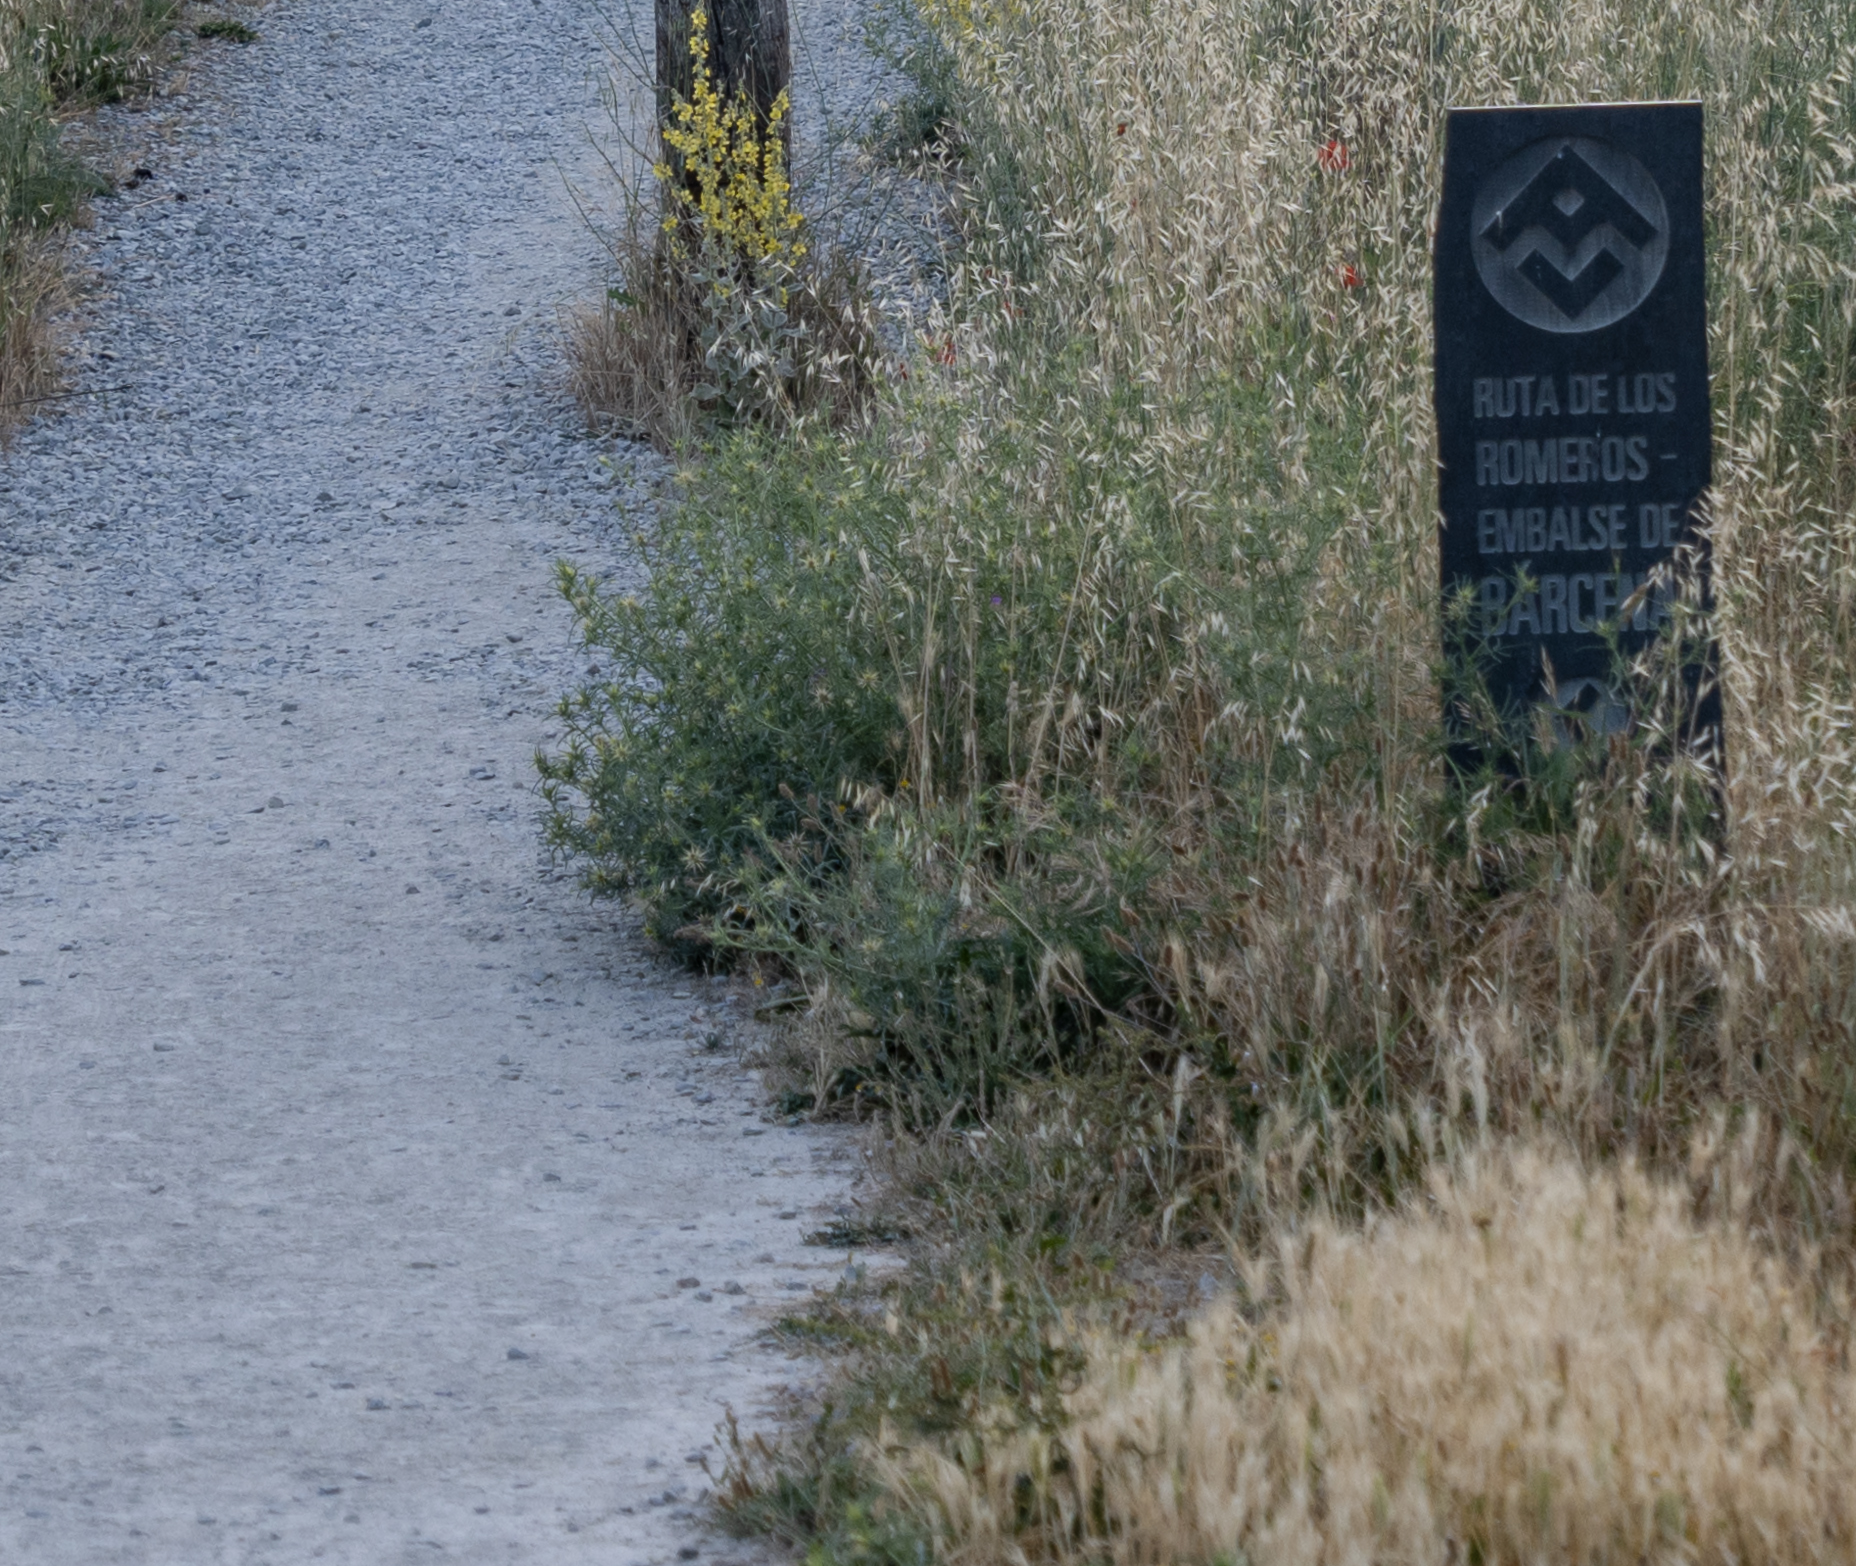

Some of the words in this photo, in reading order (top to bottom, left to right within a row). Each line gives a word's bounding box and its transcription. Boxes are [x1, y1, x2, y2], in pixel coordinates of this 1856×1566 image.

[1474, 376, 1559, 417] RUTA
[1568, 373, 1608, 414] DE
[1617, 372, 1677, 414] LOS
[1476, 438, 1647, 485] ROMEROS
[1477, 504, 1629, 554] EMBALSE
[1638, 502, 1681, 549] DE
